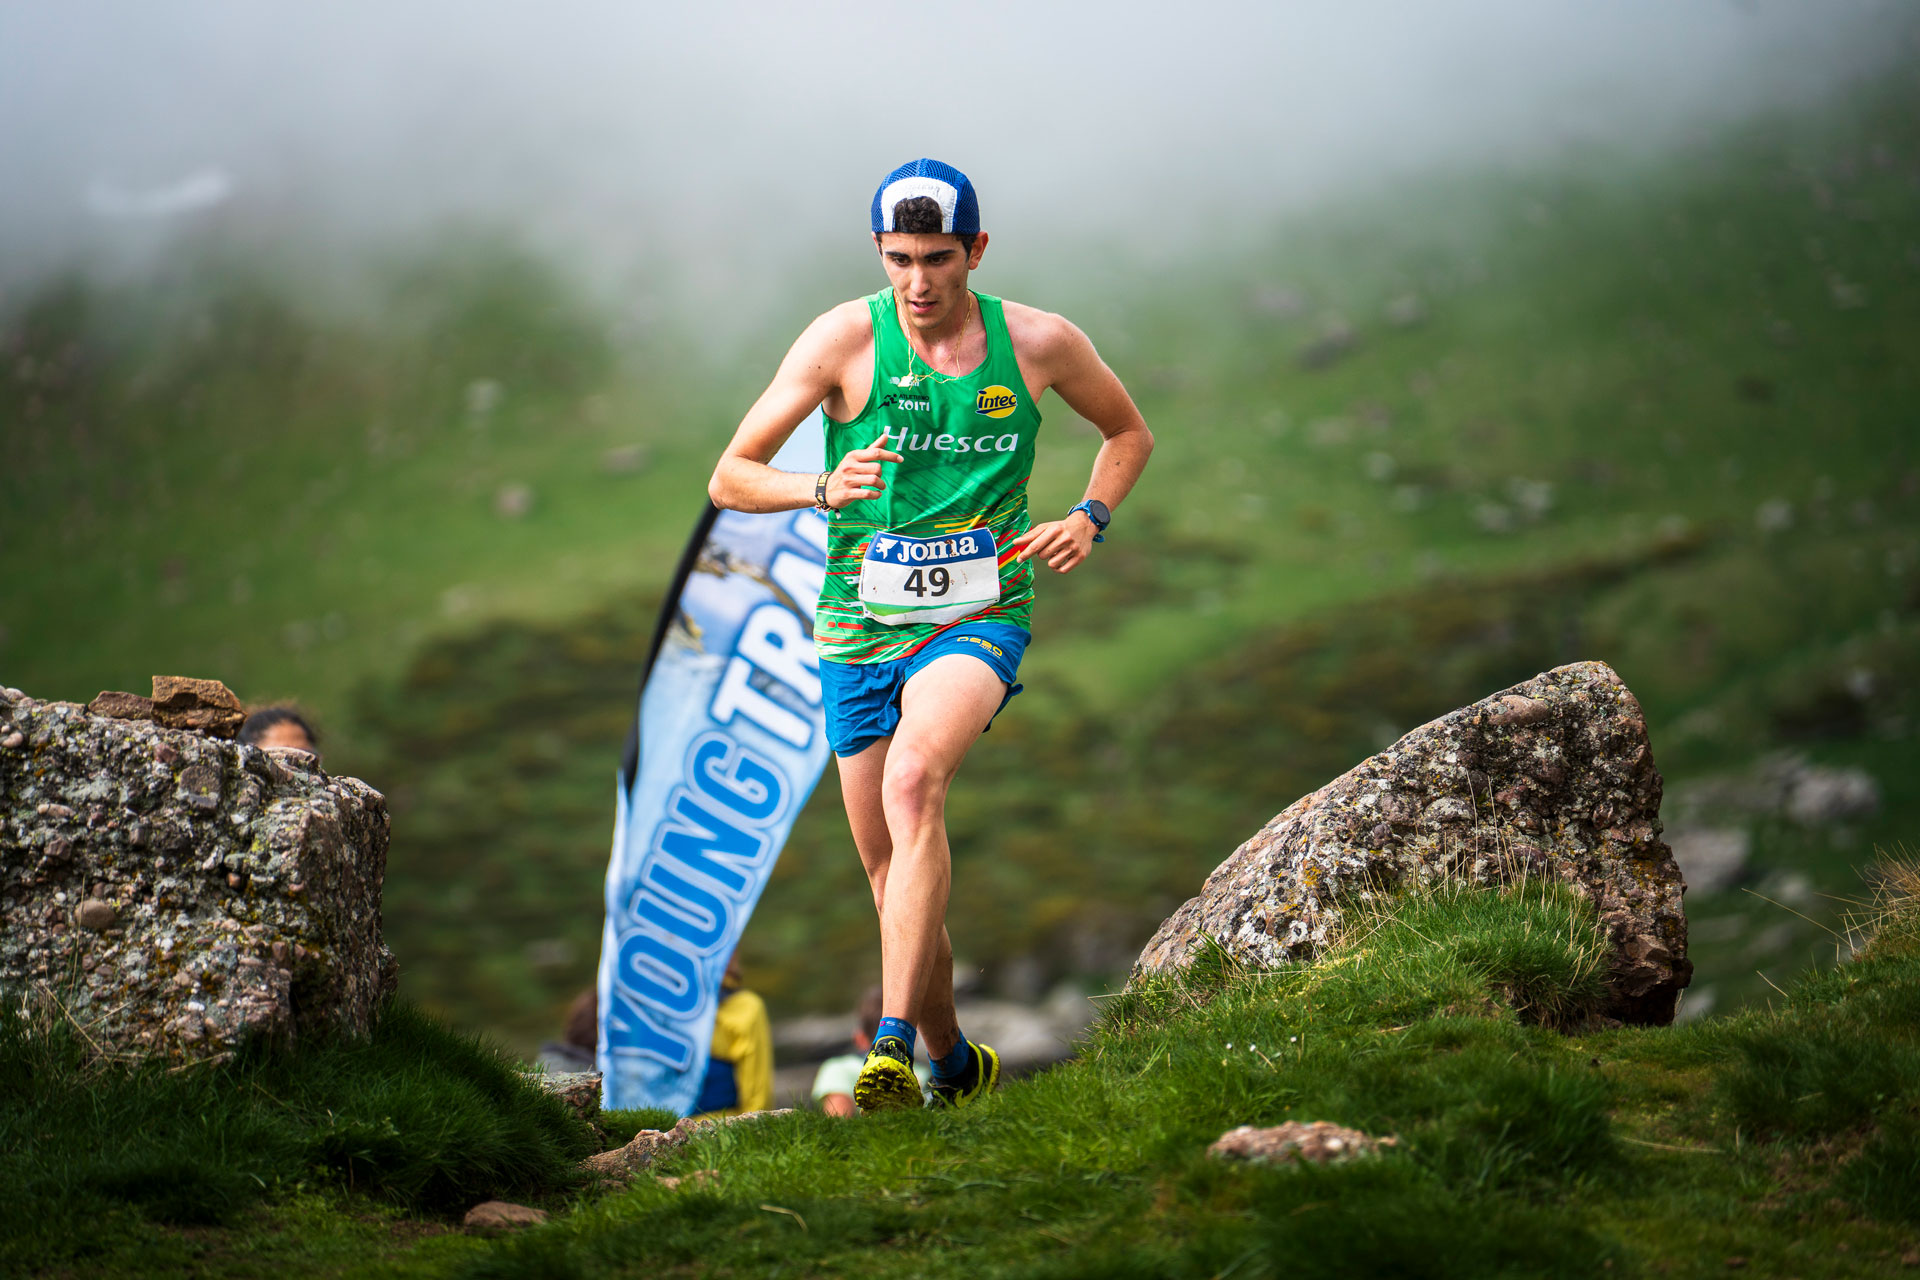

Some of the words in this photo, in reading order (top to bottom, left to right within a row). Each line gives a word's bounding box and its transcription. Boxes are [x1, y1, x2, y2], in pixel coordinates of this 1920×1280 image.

[898, 399, 930, 412] ZOITI
[883, 425, 1019, 453] Huesca
[897, 536, 979, 563] Joma
[904, 567, 950, 598] 49
